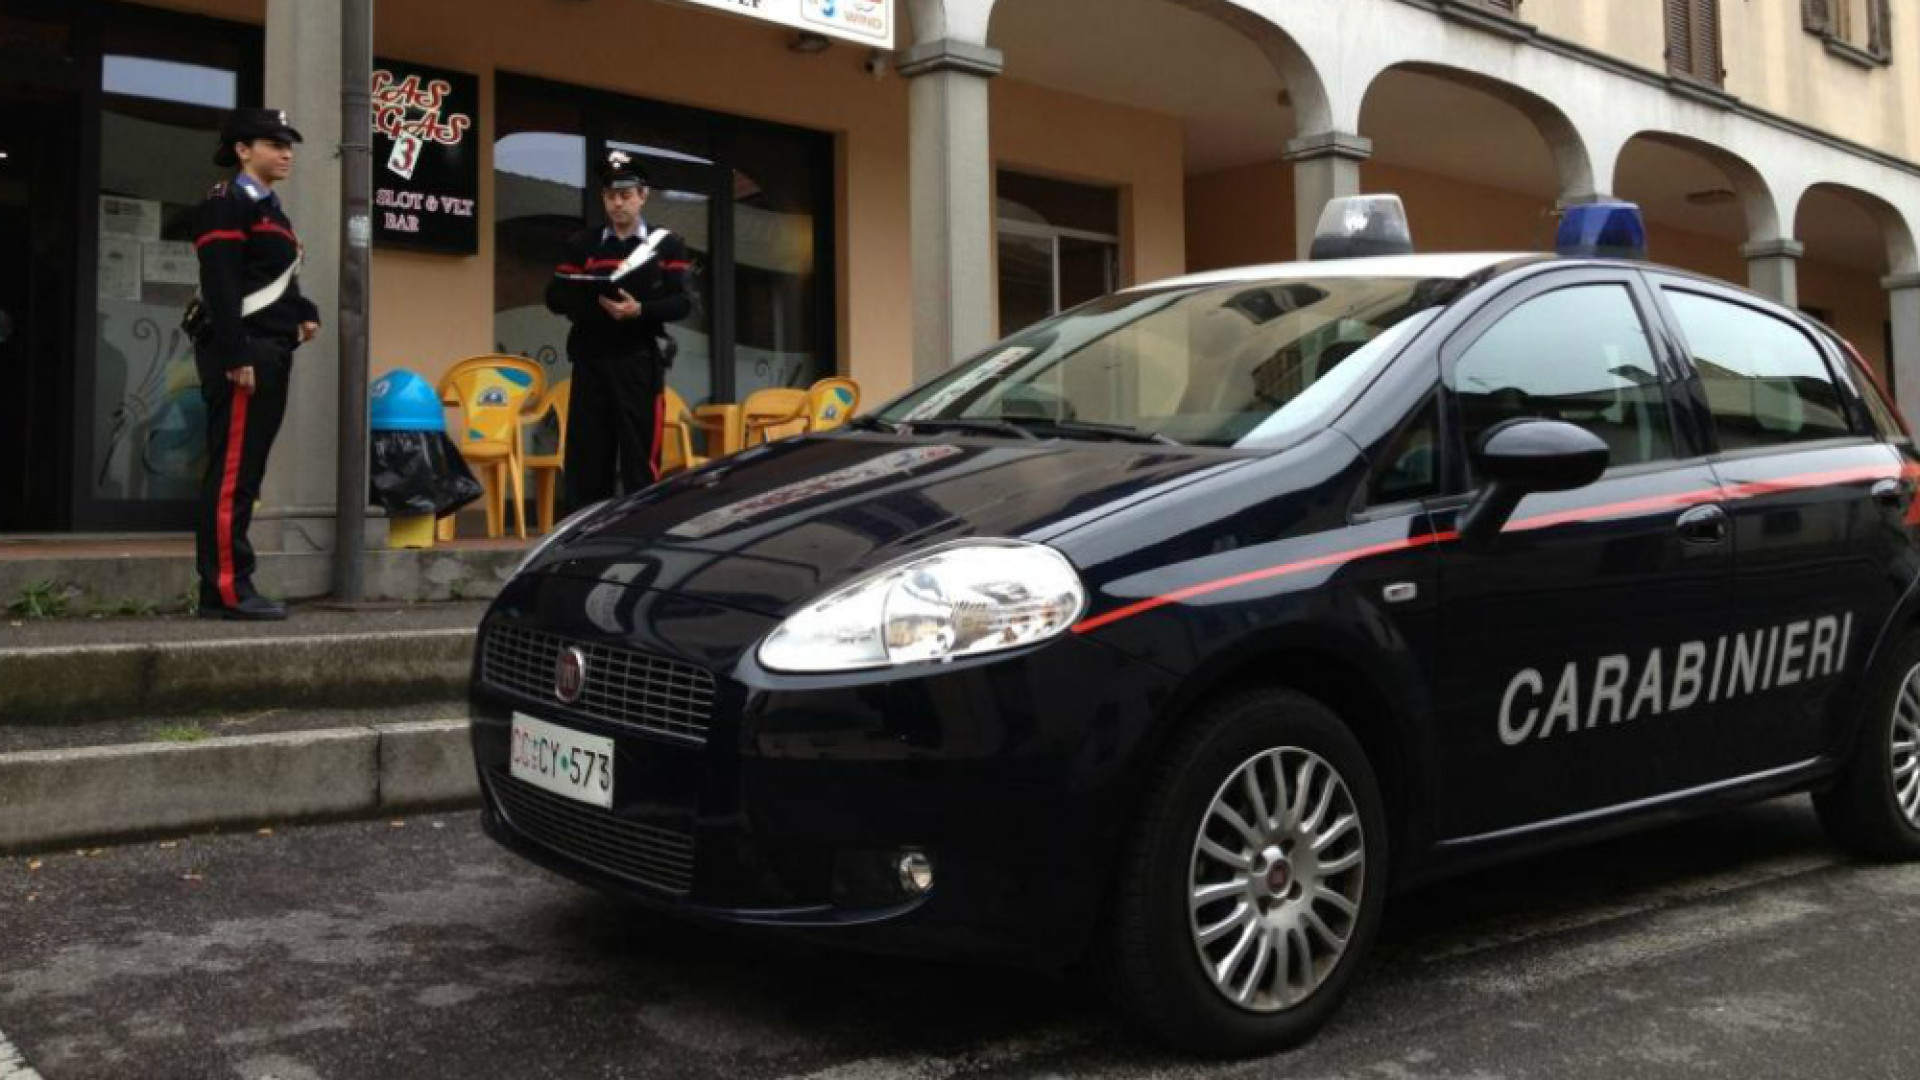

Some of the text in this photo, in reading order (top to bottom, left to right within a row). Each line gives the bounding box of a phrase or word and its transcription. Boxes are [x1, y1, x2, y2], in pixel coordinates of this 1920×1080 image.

[372, 103, 471, 145] GAS
[392, 137, 416, 171] 3
[376, 188, 475, 217] SLOT & VLT
[384, 212, 420, 232] BAR
[1497, 611, 1853, 746] CARABINIERI
[569, 746, 610, 792] 573
